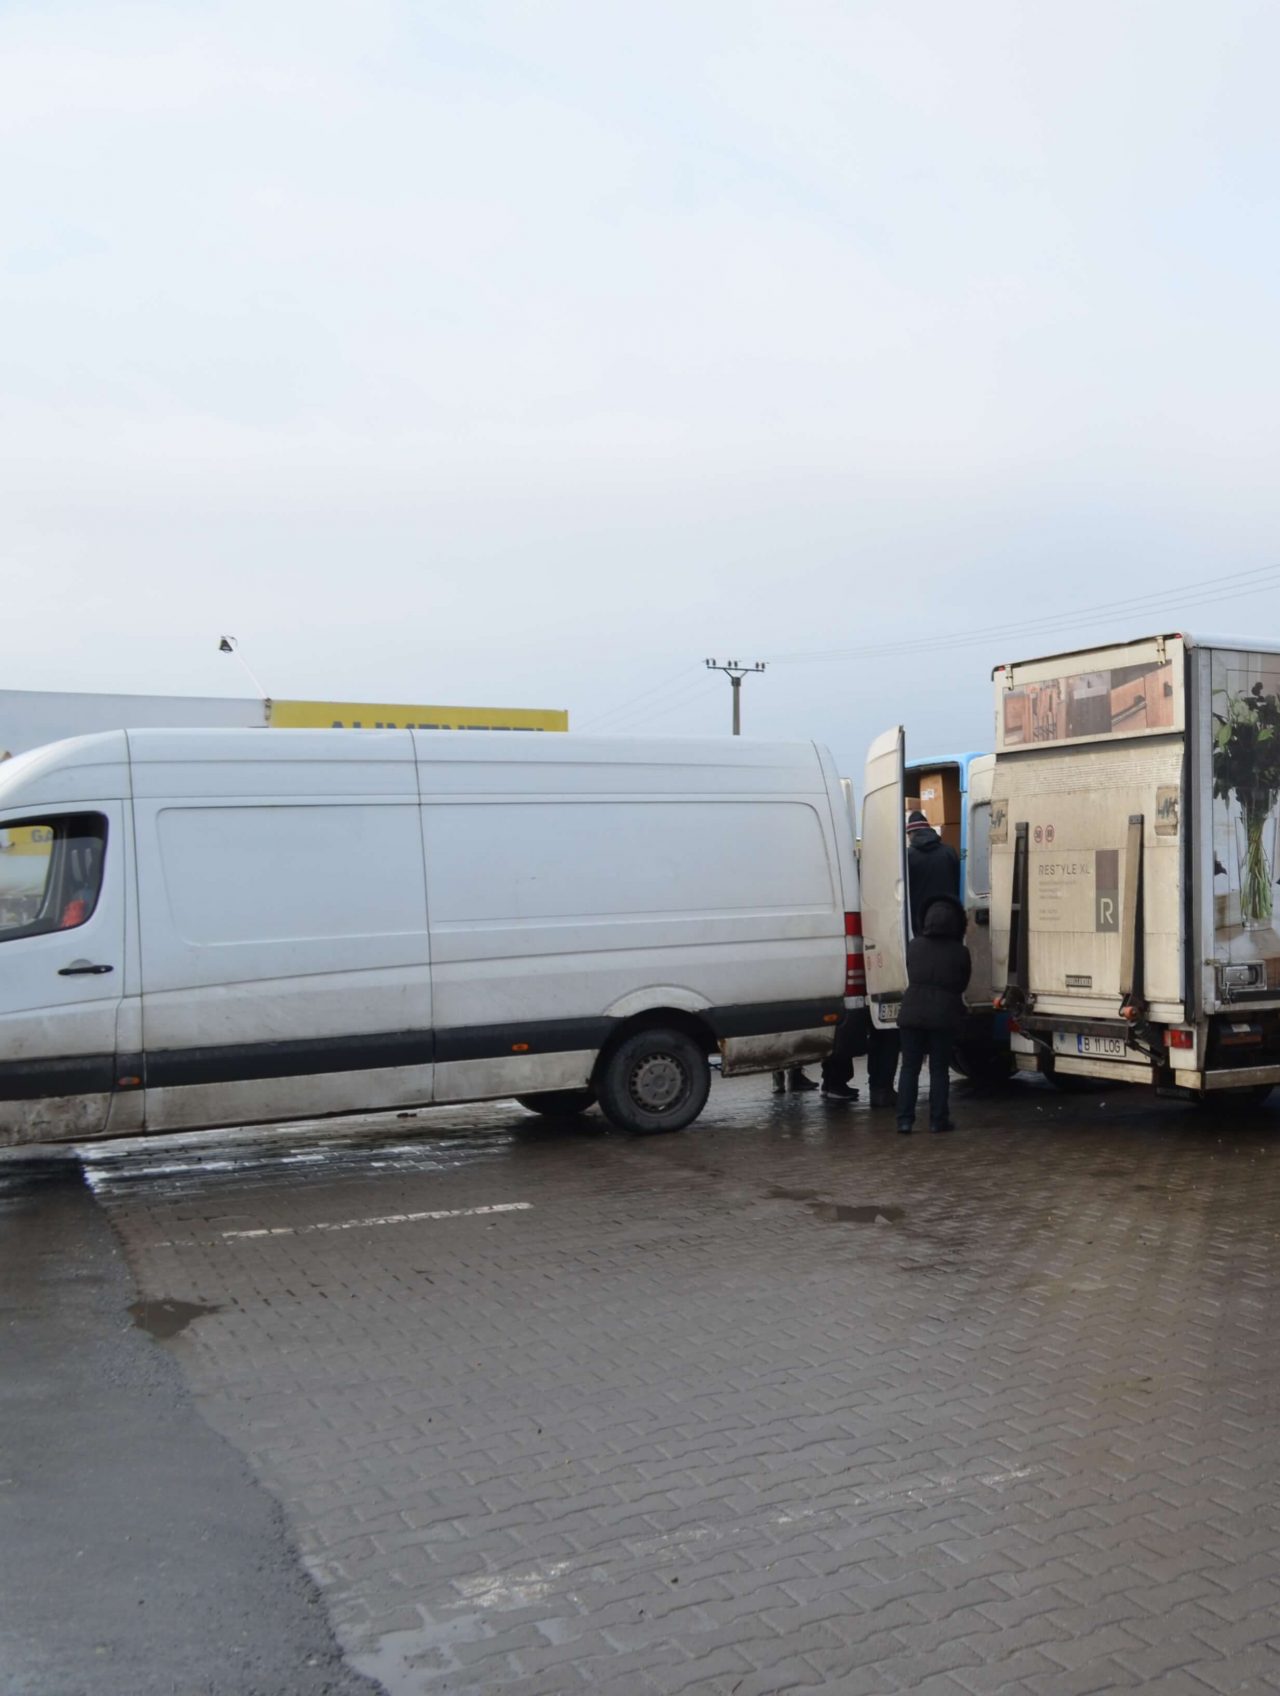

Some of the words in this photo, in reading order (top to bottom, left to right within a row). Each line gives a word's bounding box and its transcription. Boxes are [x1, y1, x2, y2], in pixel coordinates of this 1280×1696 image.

[1039, 864, 1077, 876] RESTYLE
[1101, 898, 1114, 924] R
[1084, 1037, 1090, 1051] B
[1095, 1038, 1101, 1052] 11
[1104, 1039, 1121, 1053] LOG
